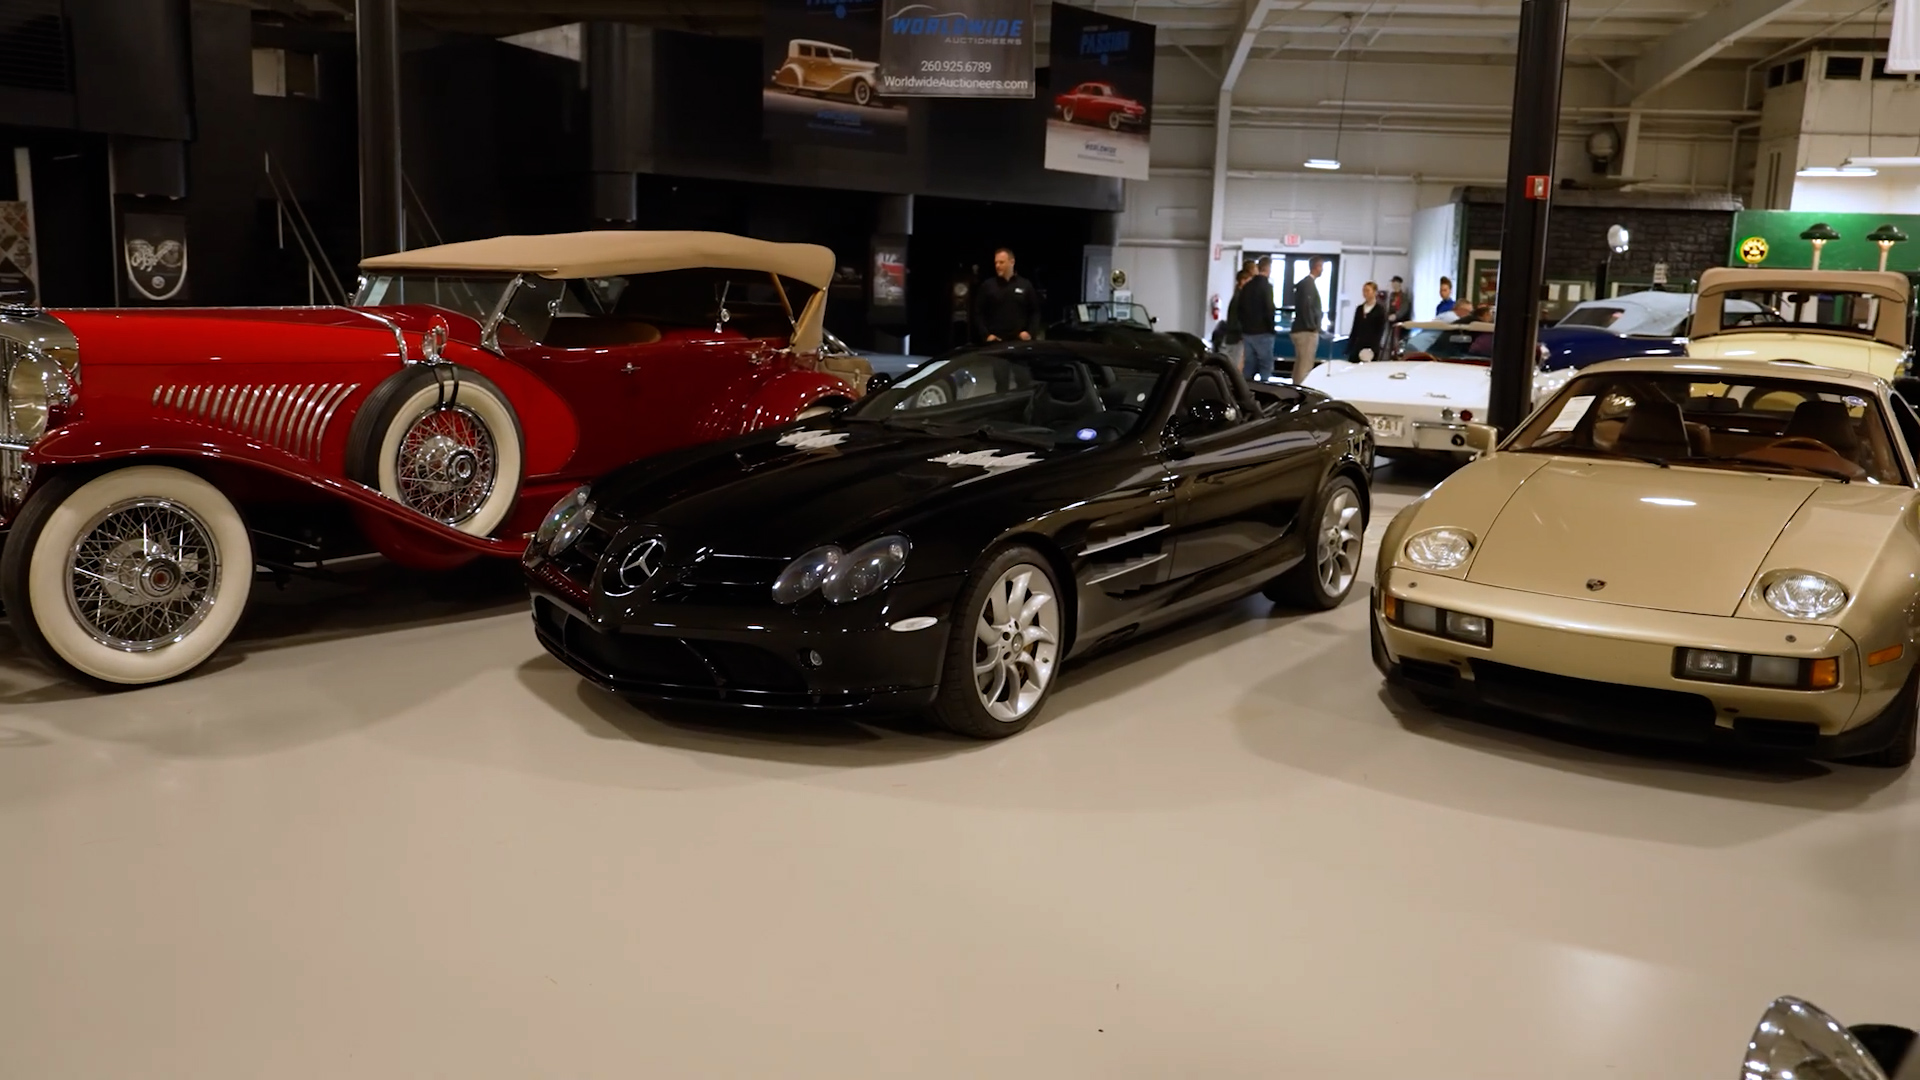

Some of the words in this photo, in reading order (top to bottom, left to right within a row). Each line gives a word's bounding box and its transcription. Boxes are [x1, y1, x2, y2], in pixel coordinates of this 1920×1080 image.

[892, 17, 1023, 37] WORLDWIDE
[944, 37, 1022, 46] AUCTIONEERS
[920, 60, 992, 73] 260.925.6789
[884, 75, 1028, 90] WorldwideAuctioneers.com
